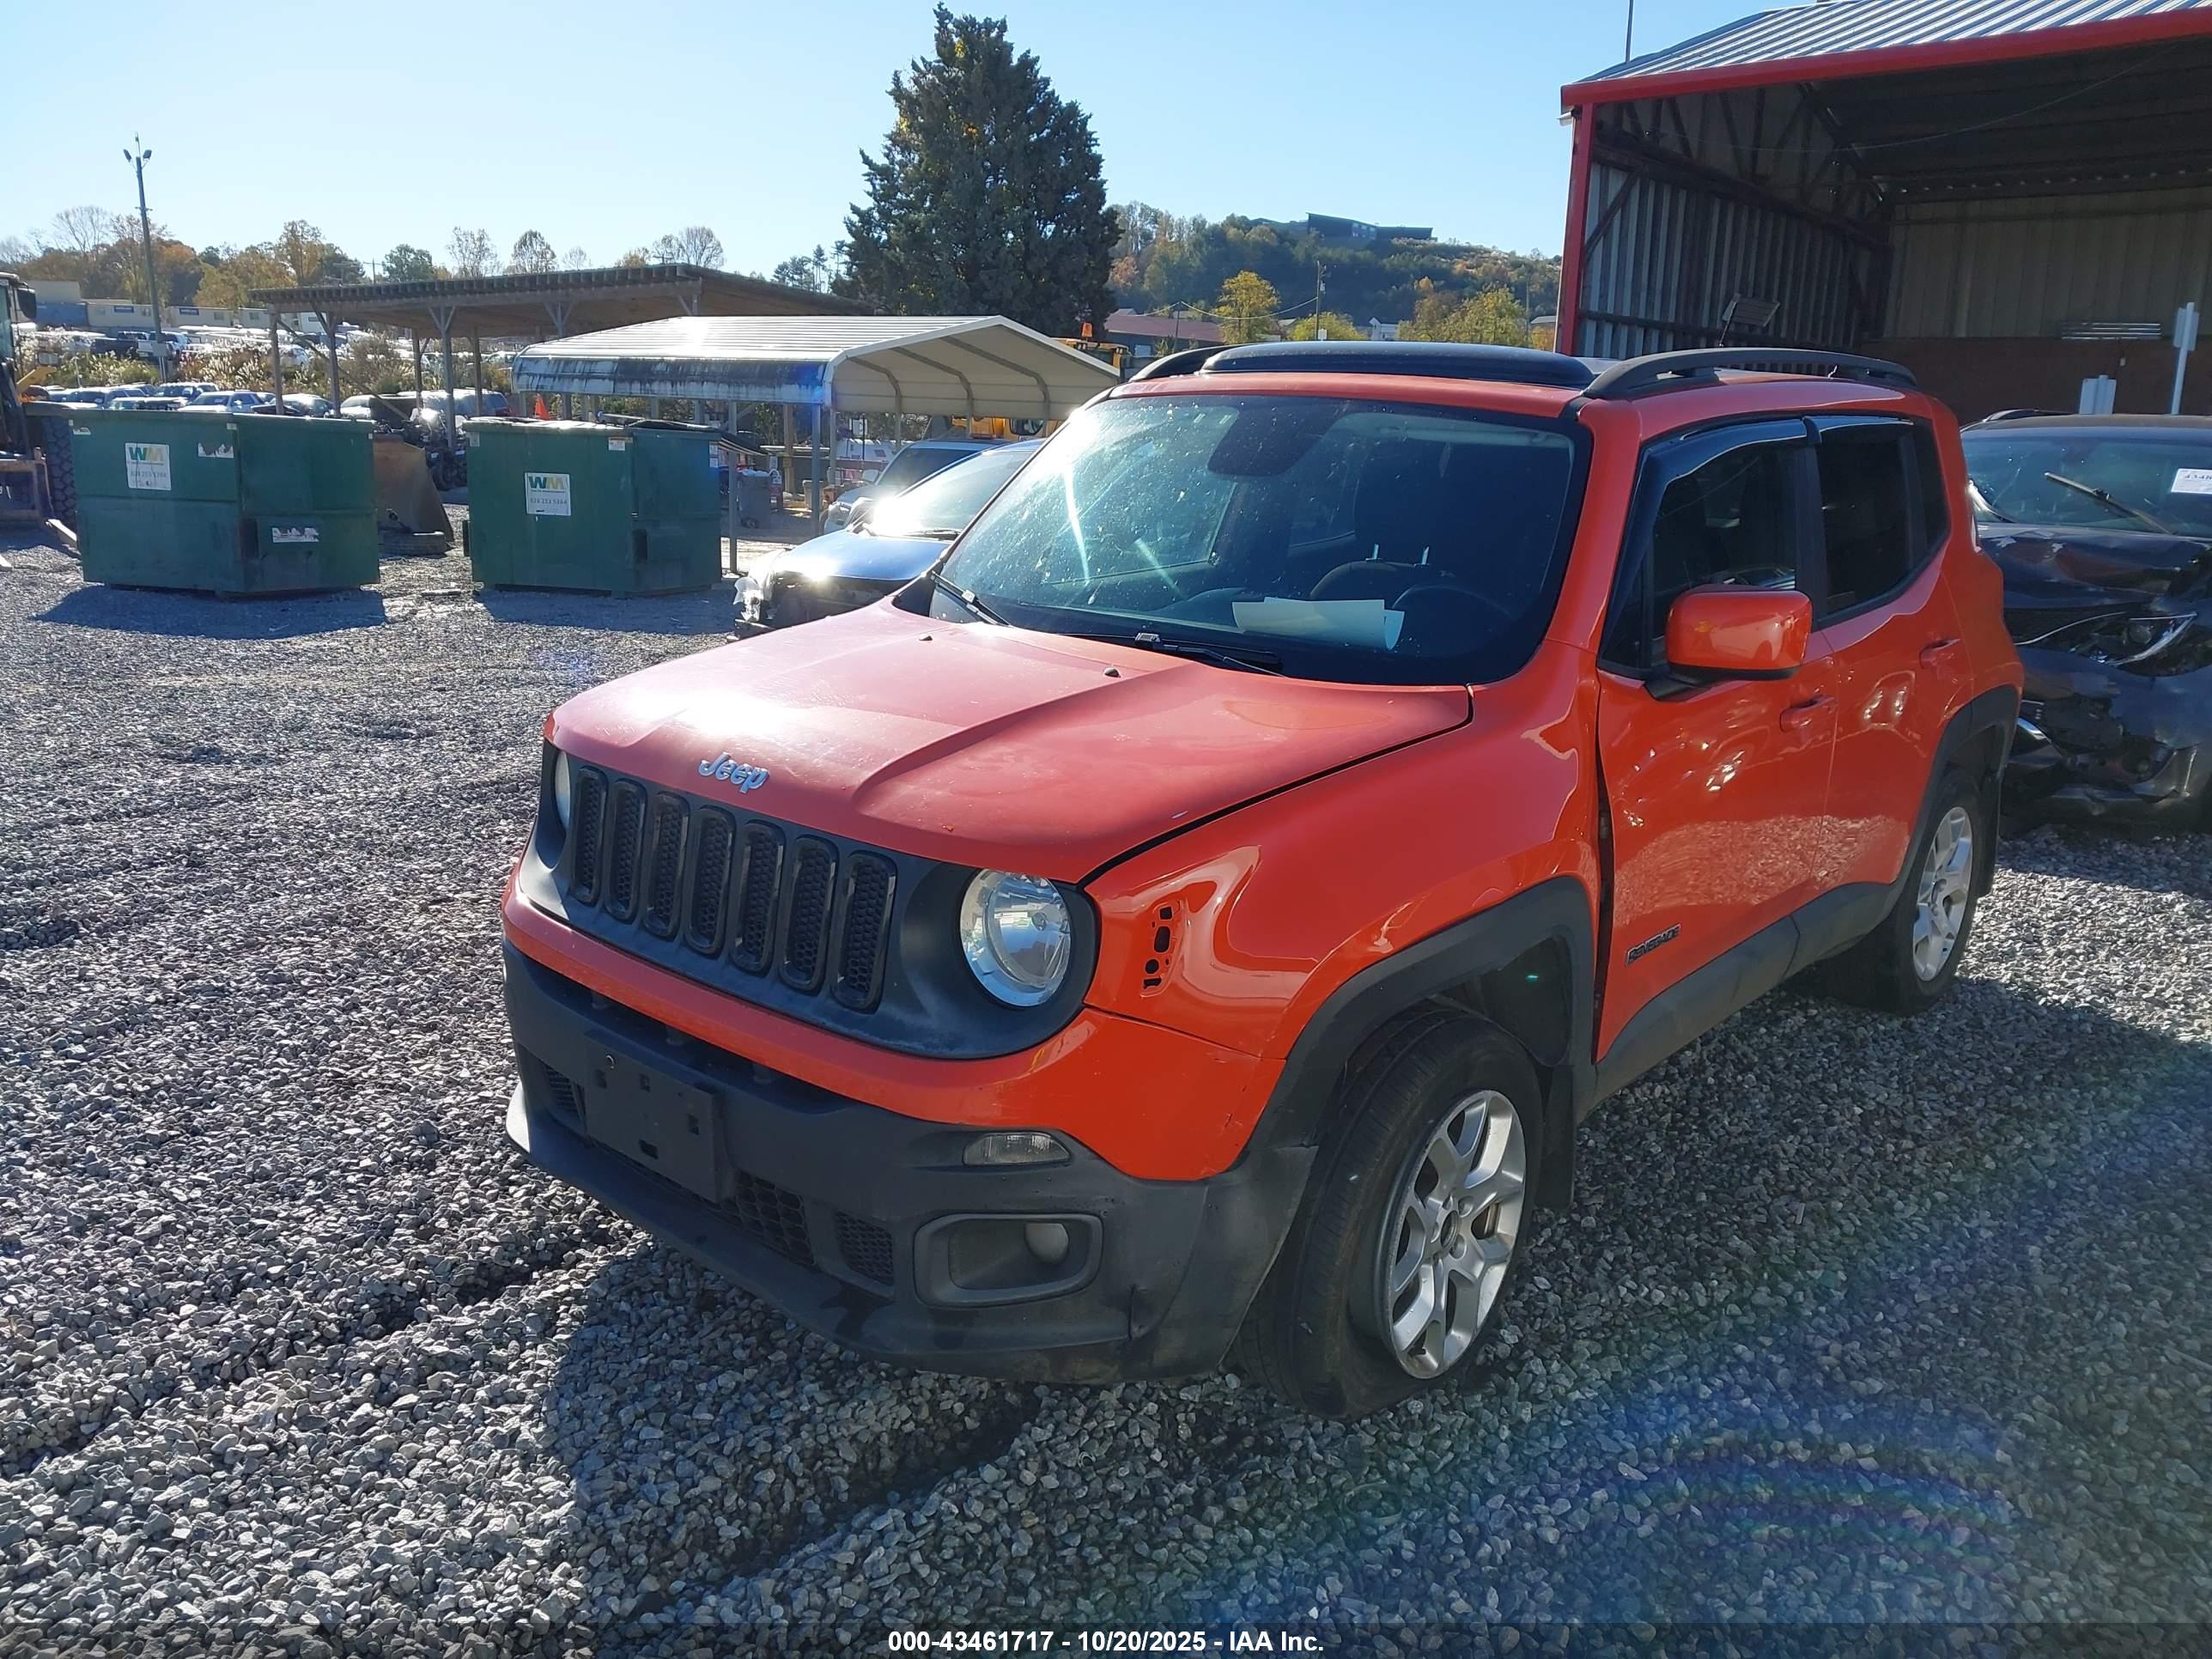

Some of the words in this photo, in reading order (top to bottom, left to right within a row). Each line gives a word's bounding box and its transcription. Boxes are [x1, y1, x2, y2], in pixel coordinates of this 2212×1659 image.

[128, 446, 166, 462] WM
[528, 476, 565, 490] WM
[698, 751, 770, 794] Jeep
